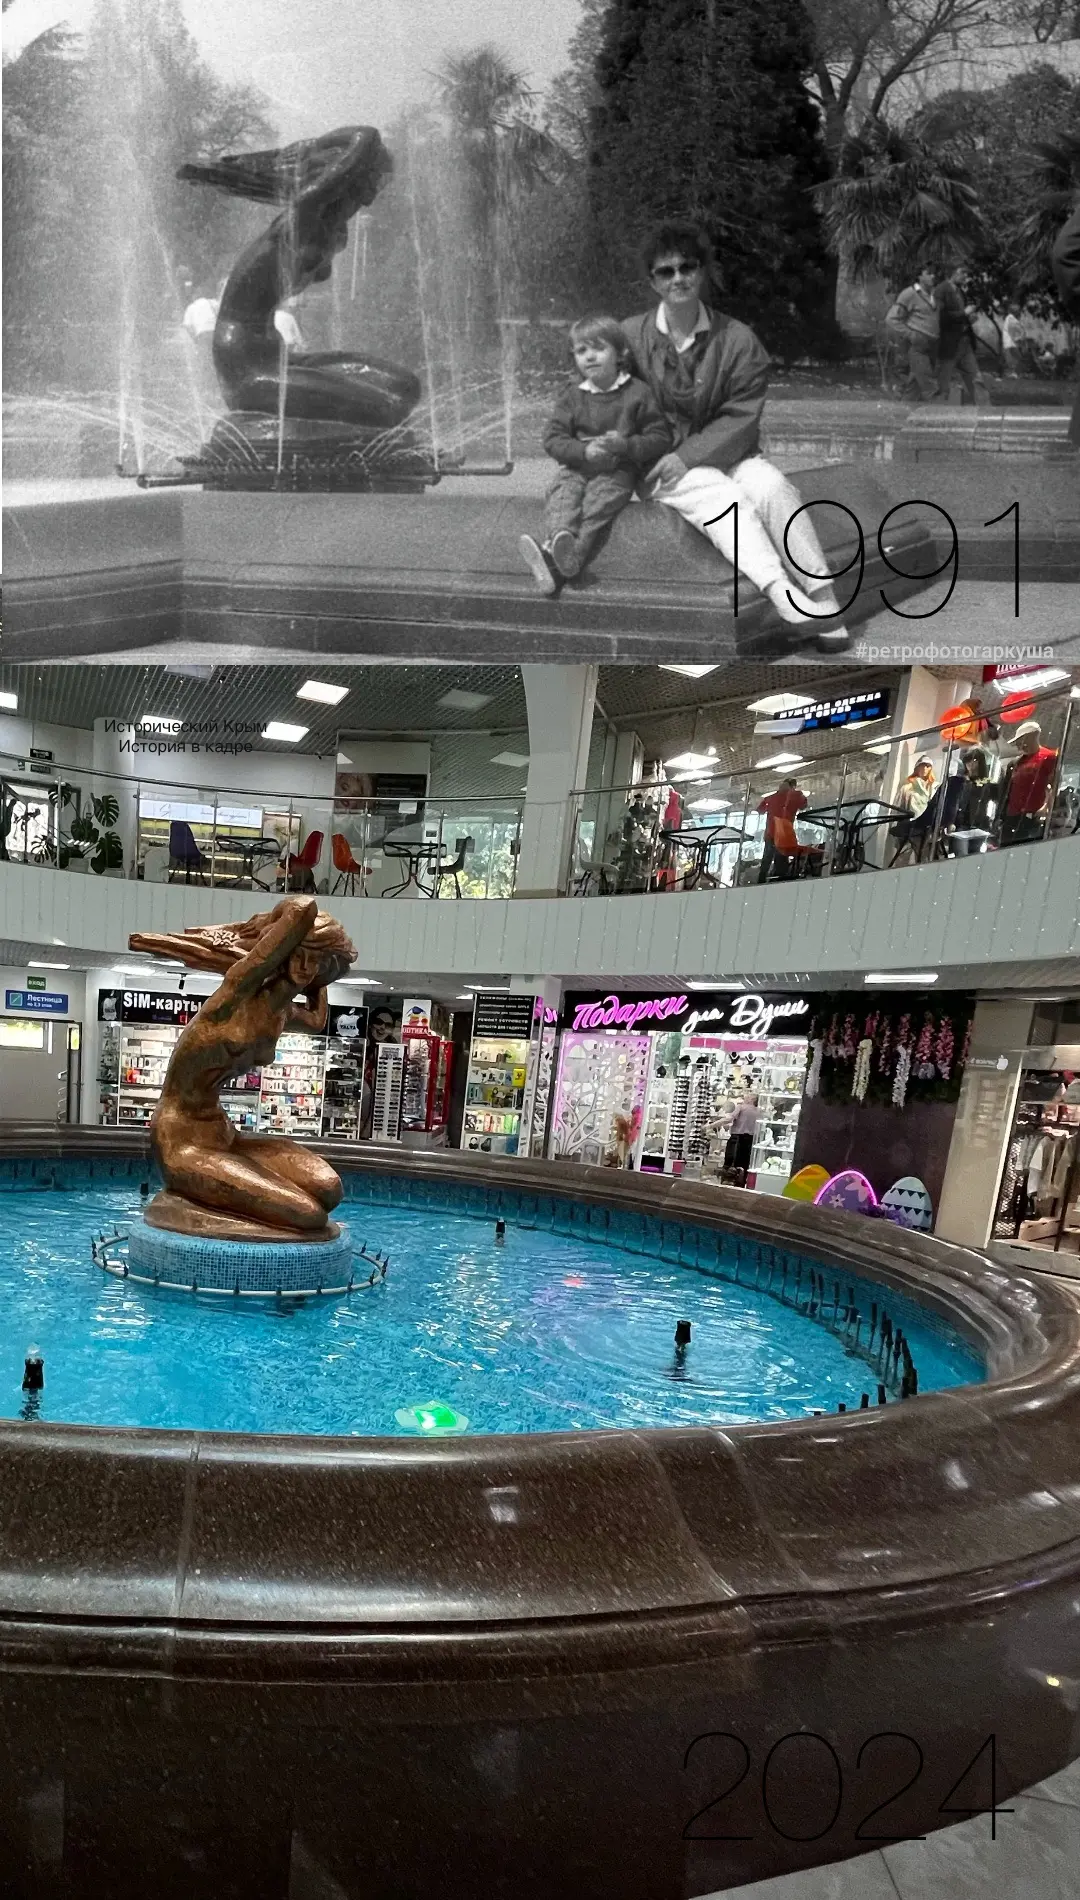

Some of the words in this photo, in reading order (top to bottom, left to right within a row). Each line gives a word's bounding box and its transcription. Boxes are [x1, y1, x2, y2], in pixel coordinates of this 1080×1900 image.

[834, 692, 881, 707] ОДЕЖДА
[27, 994, 63, 1004] Лестница
[572, 995, 689, 1031] Подарки
[681, 1008, 725, 1035] для
[729, 994, 810, 1038] Души
